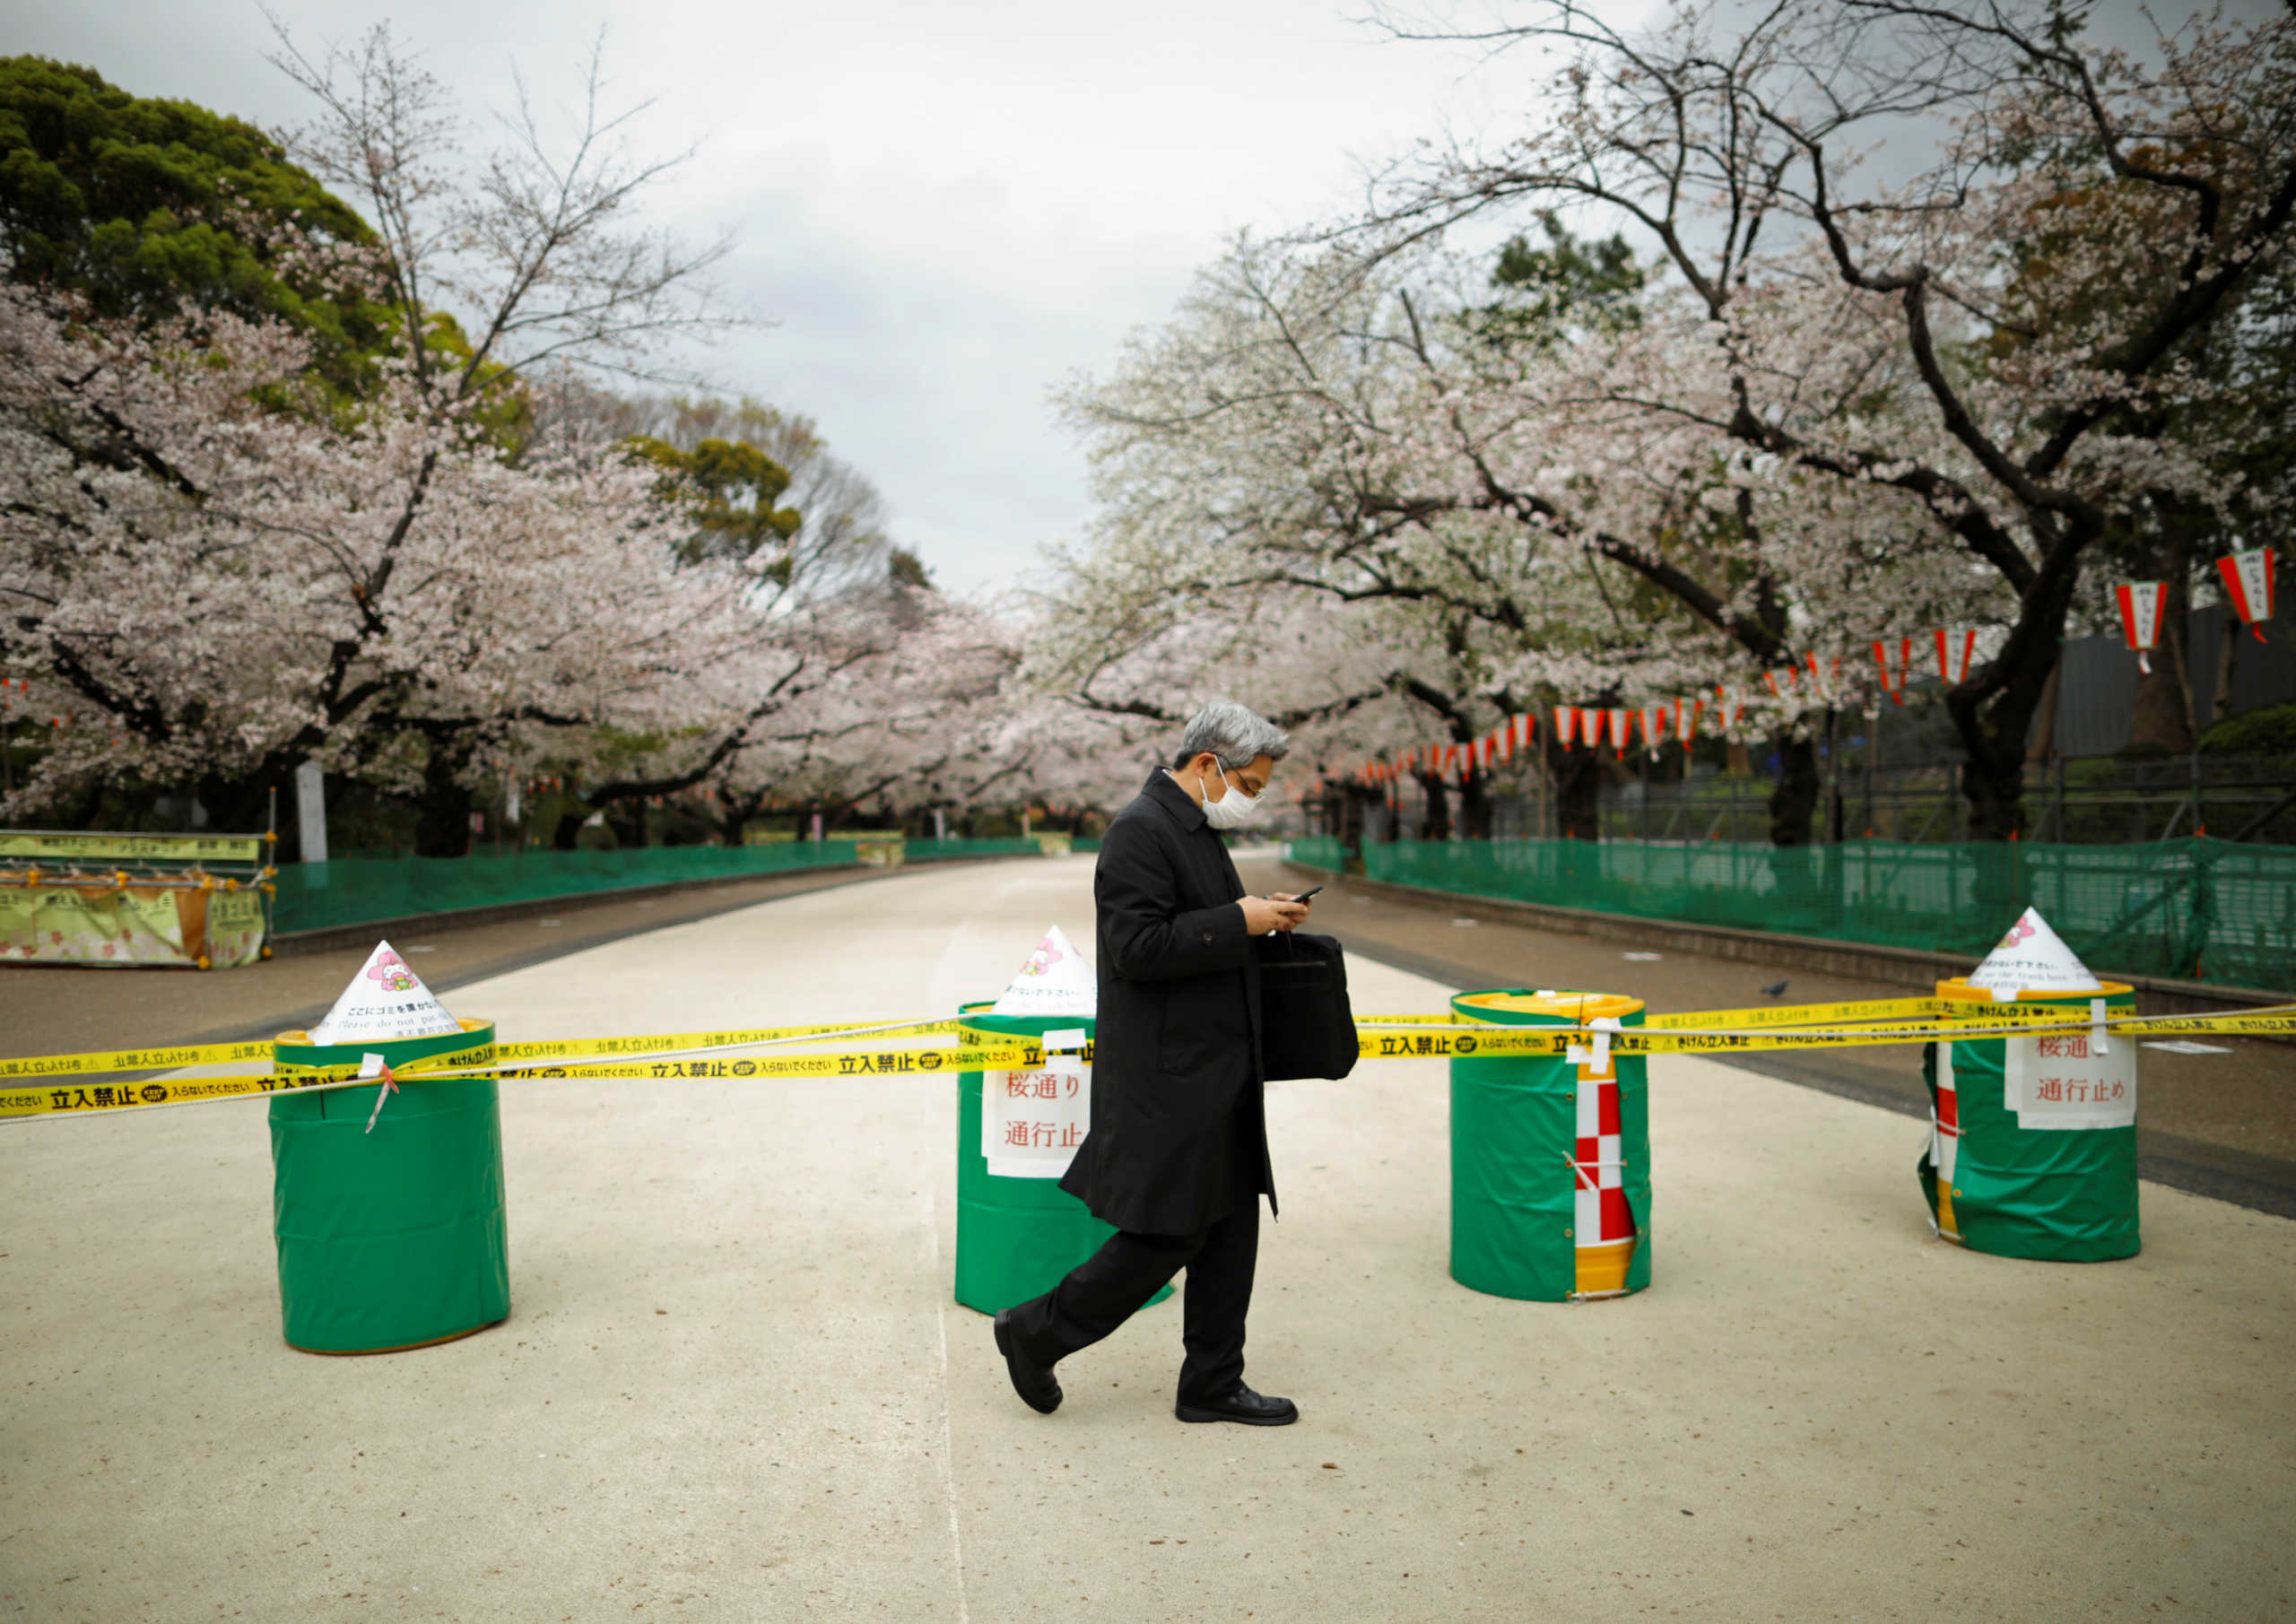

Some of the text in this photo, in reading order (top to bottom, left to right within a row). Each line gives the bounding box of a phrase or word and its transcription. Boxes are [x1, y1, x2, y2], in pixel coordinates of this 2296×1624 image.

[377, 1017, 391, 1028] do
[397, 1016, 414, 1027] not
[1379, 1036, 1451, 1055] 立入禁止
[651, 1063, 728, 1078] 立入禁止
[761, 1060, 832, 1073] 入らないでください
[839, 1053, 915, 1074] 立入禁止
[947, 1051, 1016, 1065] 入らないでください
[50, 1086, 138, 1110] 立入禁止
[173, 1082, 249, 1098] 入らないでください
[1005, 1072, 1080, 1099] 桜通り
[2037, 1078, 2125, 1103] 通行止め
